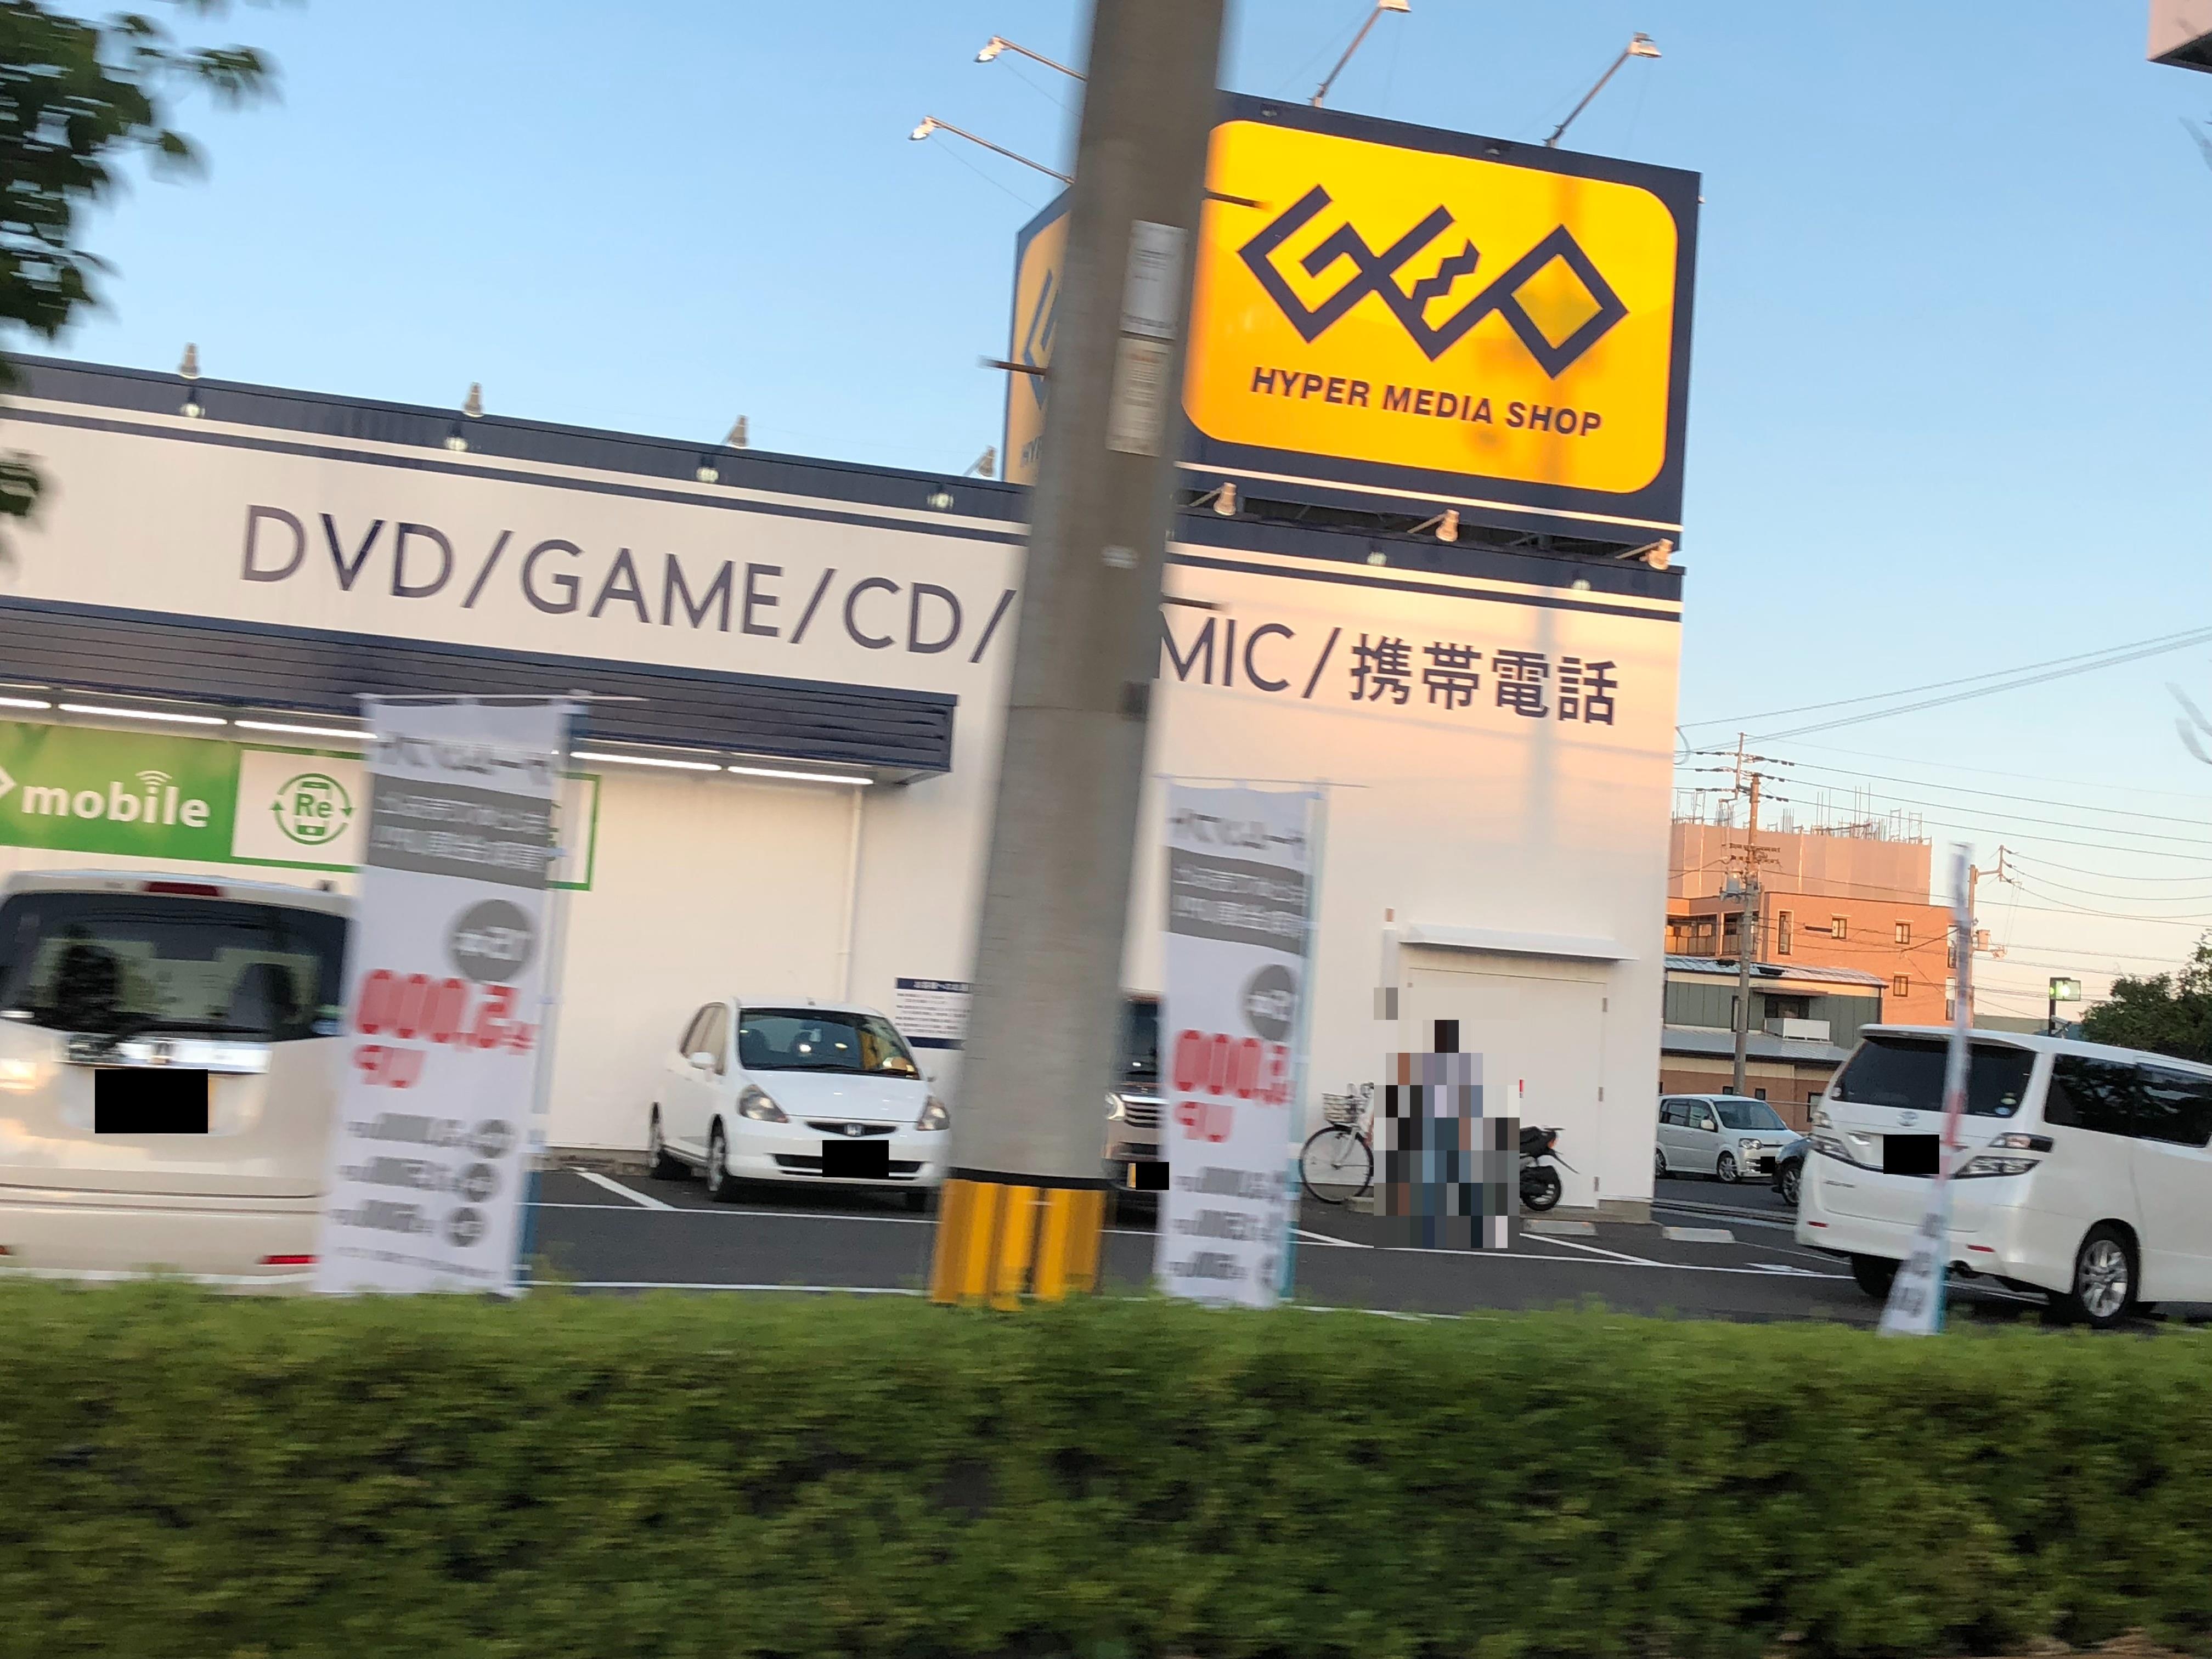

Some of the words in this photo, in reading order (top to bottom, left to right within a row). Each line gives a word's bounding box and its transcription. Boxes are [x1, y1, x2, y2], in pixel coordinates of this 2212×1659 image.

[1251, 366, 1370, 407] HYPER
[1382, 385, 1493, 425] MEDIA
[1505, 402, 1602, 437] SHOP
[22, 781, 210, 827] mobile
[294, 793, 334, 819] Re
